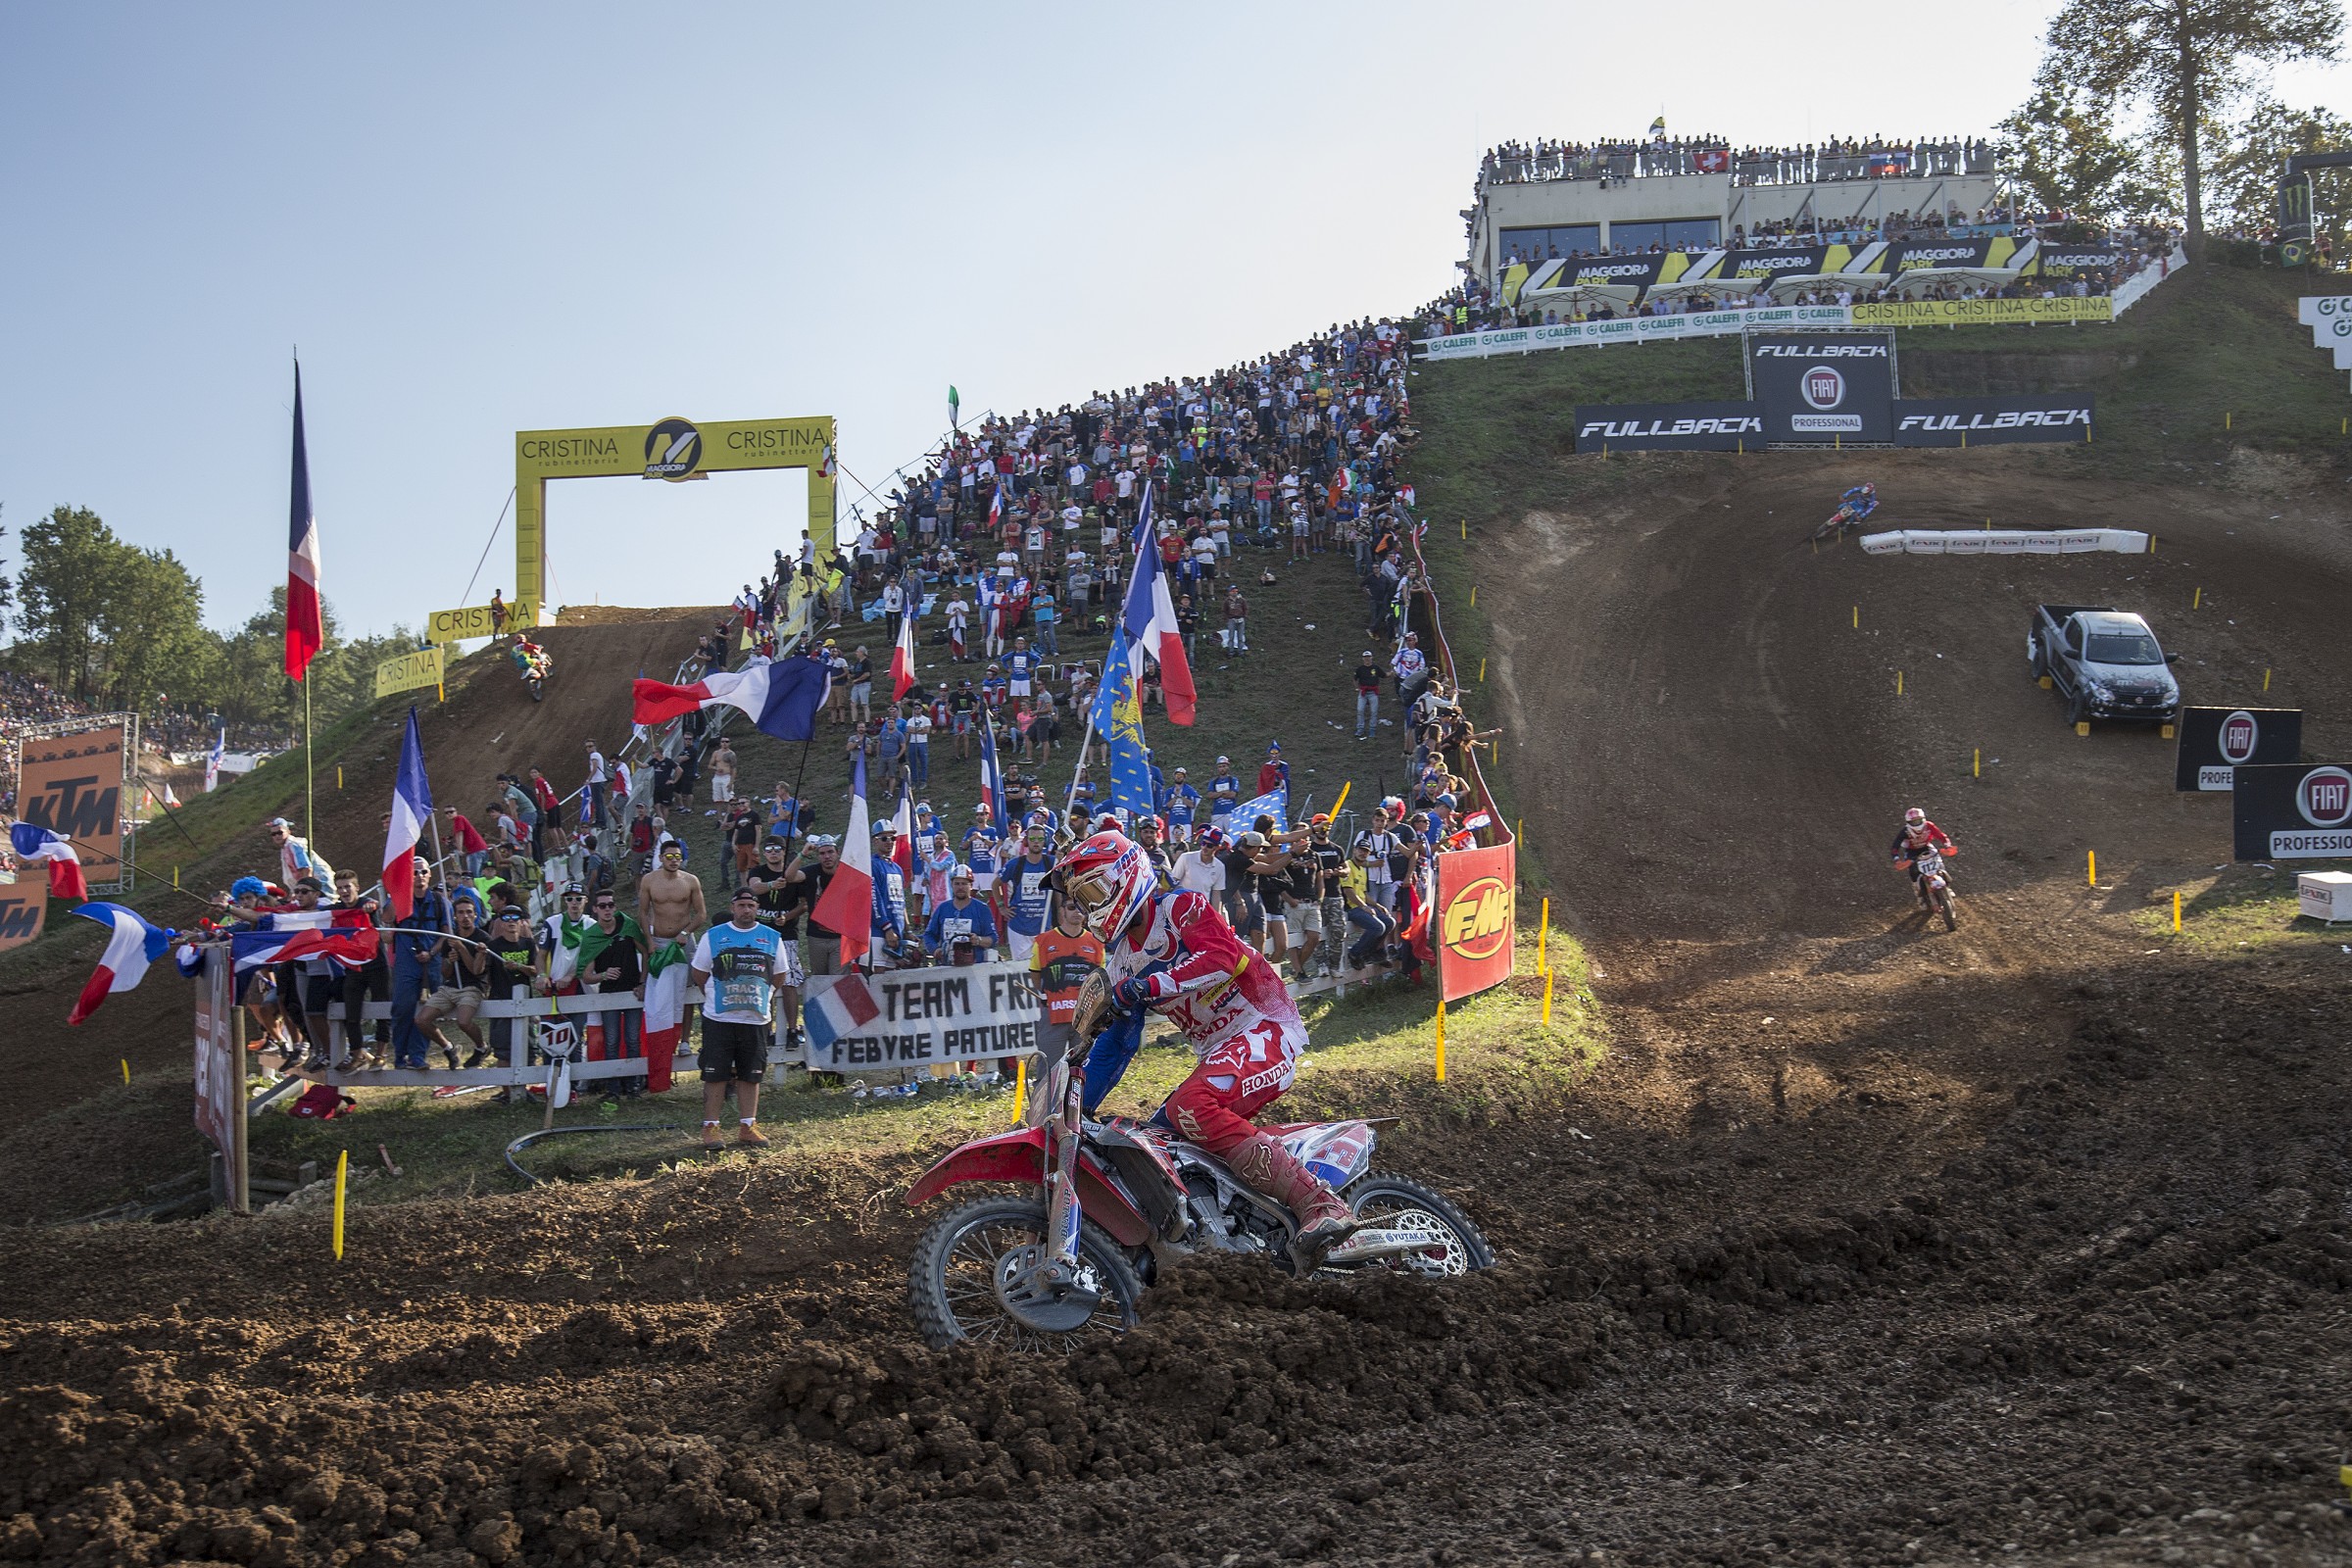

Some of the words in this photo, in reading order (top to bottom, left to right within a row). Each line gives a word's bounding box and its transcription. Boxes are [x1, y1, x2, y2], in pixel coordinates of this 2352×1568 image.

[1901, 247, 1976, 261] MAGGIORA
[1578, 264, 1650, 278] MAGGIORA
[1740, 257, 1811, 270] MAGGIORA
[1898, 260, 1936, 271] PARK
[1736, 269, 1772, 279] PARK
[1758, 310, 1791, 320] CALEFFI
[1810, 309, 1843, 318] CALEFFI
[1853, 303, 1936, 319] CRISTINA
[1943, 300, 2026, 316] CRISTINA
[2031, 298, 2110, 314] CRISTINA
[1651, 318, 1685, 329] CALEFFI
[1705, 314, 1740, 324] CALEFFI
[1548, 326, 1581, 337] CALEFFI
[1599, 322, 1633, 333] CALEFFI
[1444, 337, 1477, 348] CALEFFI
[1494, 331, 1528, 342] CALEFFI
[1755, 345, 1887, 358] FULLBACK
[1811, 379, 1836, 398] FIAT
[1580, 416, 1763, 438] FULLBACK
[1793, 417, 1860, 427] PROFESSIONAL
[1898, 409, 2091, 431] FULLBACK
[726, 427, 827, 450] CRISTINA
[521, 437, 619, 459] CRISTINA
[539, 457, 619, 467] rubinetterie
[436, 603, 531, 632] CRISTNA
[379, 653, 437, 685] CRISTINA
[2228, 727, 2250, 749] FIAT
[2312, 785, 2346, 810] FIAT
[24, 775, 119, 838] KTM
[0, 899, 40, 939] TM
[1446, 887, 1509, 947] FMF
[725, 984, 762, 996] TRACK
[883, 977, 972, 1022] TEAM
[545, 1030, 568, 1047] 10
[1243, 1062, 1291, 1094] HONDA
[1178, 1105, 1208, 1141] FOX
[1060, 1188, 1072, 1240] DUNLOP
[1393, 1232, 1426, 1242] YUTAKA
